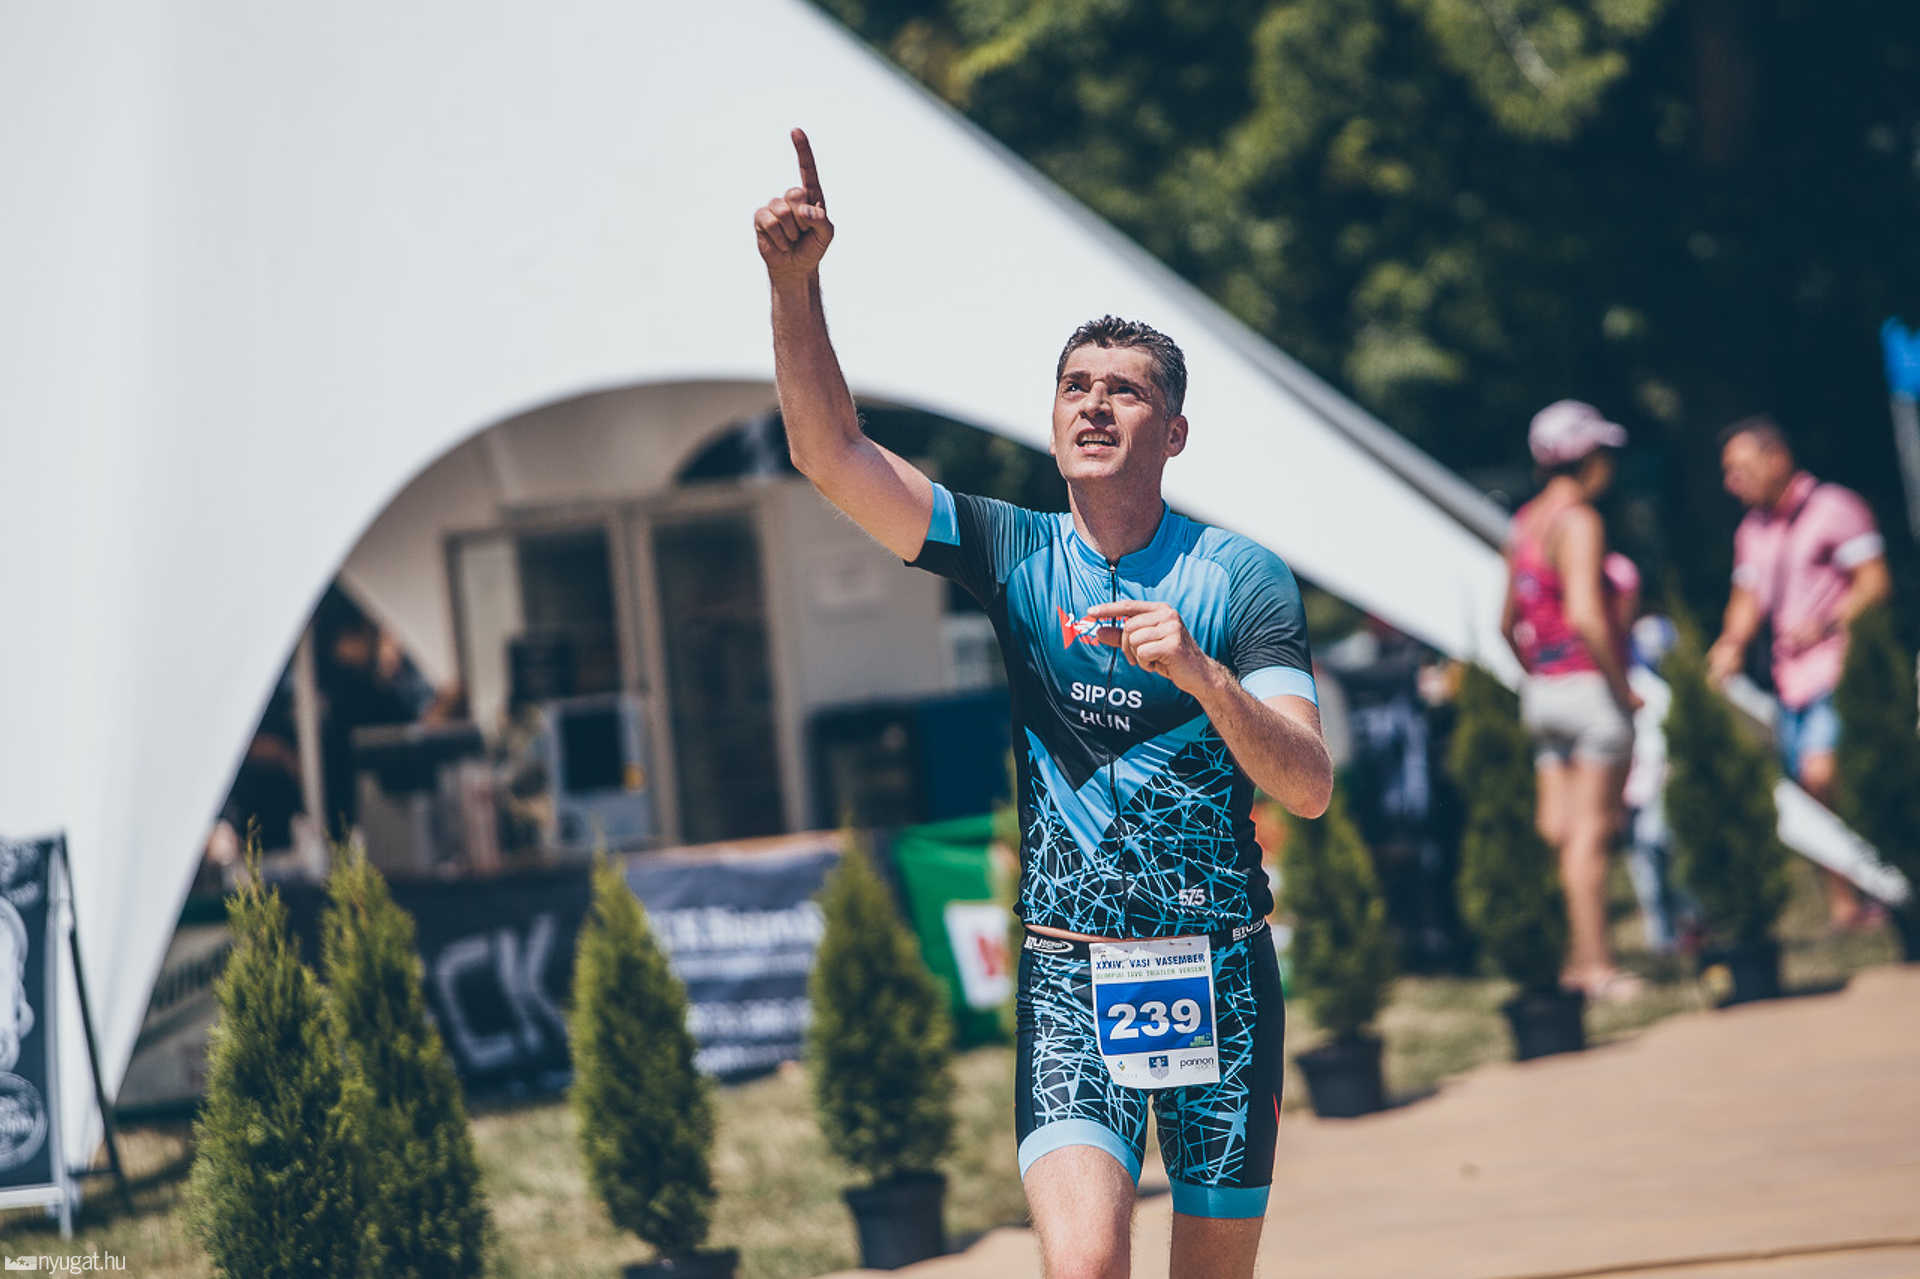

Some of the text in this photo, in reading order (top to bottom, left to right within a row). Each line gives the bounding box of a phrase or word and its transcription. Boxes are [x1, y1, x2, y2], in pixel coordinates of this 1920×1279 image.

[1070, 681, 1143, 709] SIPOS
[1178, 888, 1206, 907] 575
[1129, 959, 1150, 969] VASI
[1155, 953, 1206, 967] VASEMBER
[1107, 998, 1202, 1041] 239
[1179, 1056, 1215, 1070] pannon
